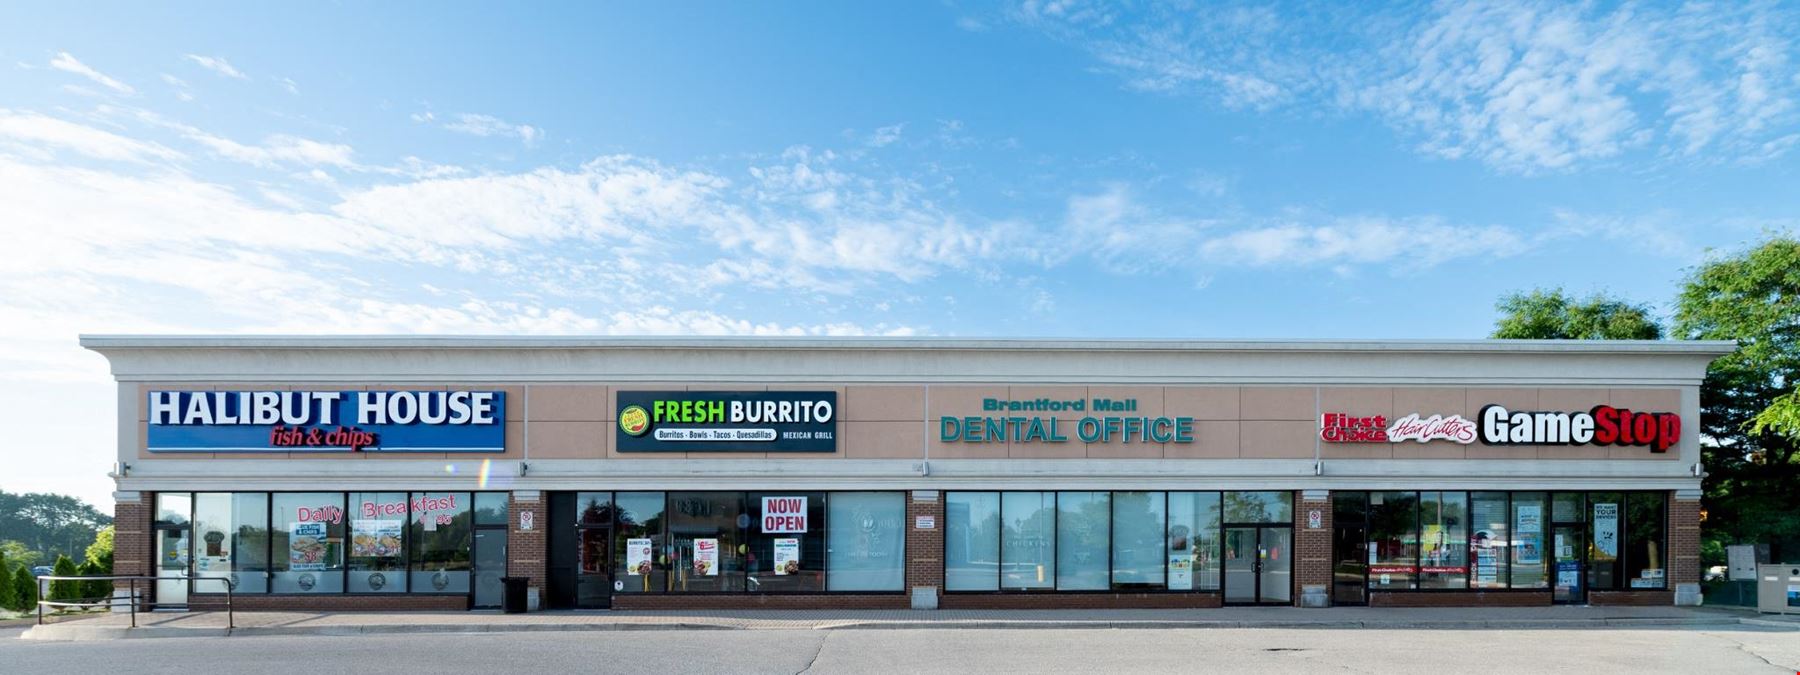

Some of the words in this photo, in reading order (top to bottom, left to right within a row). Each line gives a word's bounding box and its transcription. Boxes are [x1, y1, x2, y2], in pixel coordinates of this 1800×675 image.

[150, 391, 341, 425] HALIBUT
[357, 391, 494, 425] HOUSE
[653, 400, 724, 422] FRESH
[730, 400, 833, 423] BURRITO
[982, 398, 1085, 411] Brantford
[1093, 398, 1137, 411] Mall
[1321, 413, 1387, 428] First
[1483, 403, 1681, 450] GameStop
[659, 430, 684, 439] Burritos
[689, 430, 707, 439] Bowls
[713, 430, 731, 439] Tacos
[736, 430, 772, 439] Quesadillas
[782, 431, 811, 439] MEXICAN
[814, 431, 832, 439] GRILL
[940, 416, 1068, 442] DENTAL
[1076, 416, 1195, 443] OFFICE
[1320, 427, 1388, 442] Choice
[269, 426, 303, 447] fish
[306, 427, 322, 446] &
[325, 426, 374, 452] chips
[298, 506, 343, 524] Daily
[363, 495, 456, 517] Breakfast
[767, 498, 802, 514] NOW
[765, 516, 805, 531] OPEN
